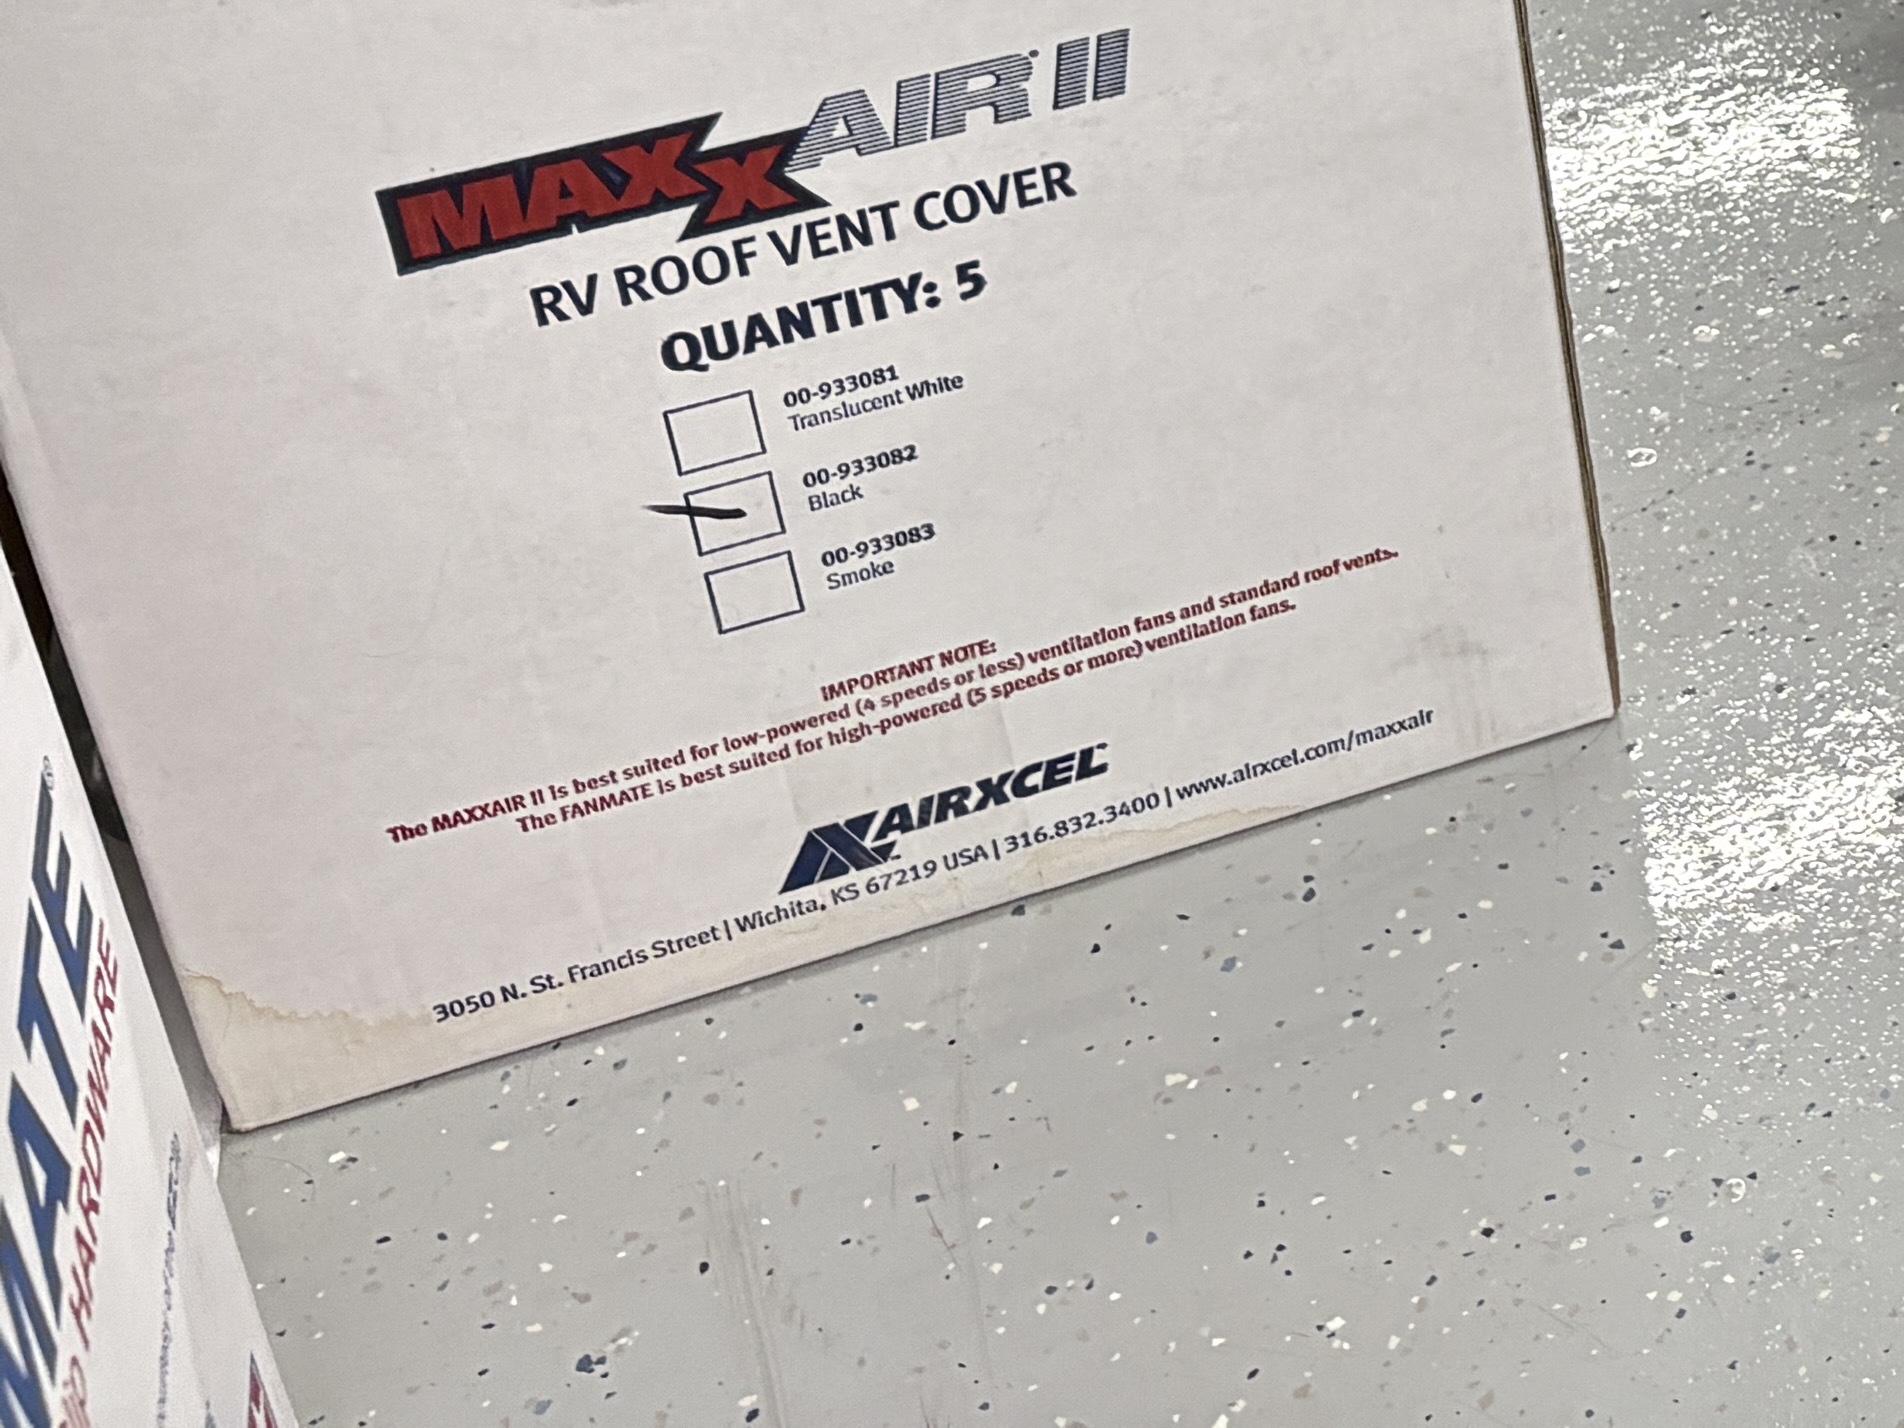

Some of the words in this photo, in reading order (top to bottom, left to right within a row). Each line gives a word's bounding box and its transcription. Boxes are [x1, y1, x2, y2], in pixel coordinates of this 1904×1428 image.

[1052, 27, 1131, 112] II
[529, 273, 600, 327] RV
[614, 235, 758, 307] ROOF
[767, 199, 900, 269] VENT
[913, 159, 1077, 232] COVER
[659, 271, 941, 372] QUANTITY:
[957, 259, 988, 302] 5
[782, 364, 899, 408] 00-933081
[788, 389, 905, 432] Translucent
[904, 374, 965, 402] White
[802, 443, 919, 488] 00-933082
[807, 484, 865, 512] Black
[820, 522, 936, 568] 00-933083
[826, 560, 895, 591] Smoke
[386, 822, 428, 843] The
[431, 792, 526, 834] MAXXAIR
[530, 788, 545, 807] II
[548, 783, 569, 802] is
[572, 769, 619, 796] best
[621, 749, 687, 782] suited
[689, 742, 720, 766] for
[721, 700, 851, 754] low-powered
[855, 695, 876, 719] (4
[879, 673, 951, 711] speeds
[954, 668, 975, 686] or
[978, 652, 1026, 682] less)
[1027, 621, 1131, 665] ventilation
[1134, 608, 1176, 635] fans
[1179, 594, 1216, 620] and
[1218, 571, 1301, 611] standard
[1302, 559, 1341, 585] roof
[1341, 547, 1399, 573] vents.
[820, 656, 937, 703] IMPORTANT
[939, 639, 997, 668] NOTE:
[515, 810, 557, 834] The
[559, 782, 655, 824] FANMATE
[656, 777, 677, 796] is
[679, 762, 726, 791] best
[728, 744, 792, 776] suited
[794, 735, 825, 759] for
[827, 693, 965, 750] high-powered
[967, 685, 987, 710] (5
[990, 666, 1061, 705] speeds
[1063, 660, 1085, 680] or
[1086, 639, 1144, 671] more)
[1145, 610, 1247, 653] ventilation
[1249, 597, 1297, 624] fans.
[870, 744, 1109, 843] AIRXCEL
[432, 989, 497, 1024] 3050
[499, 980, 528, 1004] N.
[529, 971, 565, 995] St.
[567, 948, 649, 985] Francis
[651, 925, 721, 959] Street
[734, 896, 827, 935] Wichita,
[830, 882, 861, 907] KS
[865, 858, 938, 898] 67219
[942, 841, 990, 876] USA
[1004, 791, 1161, 855] 316.832.3400
[1176, 708, 1435, 802] www.airxcel.com/maxxair
[70, 917, 119, 1352] HARDWARE
